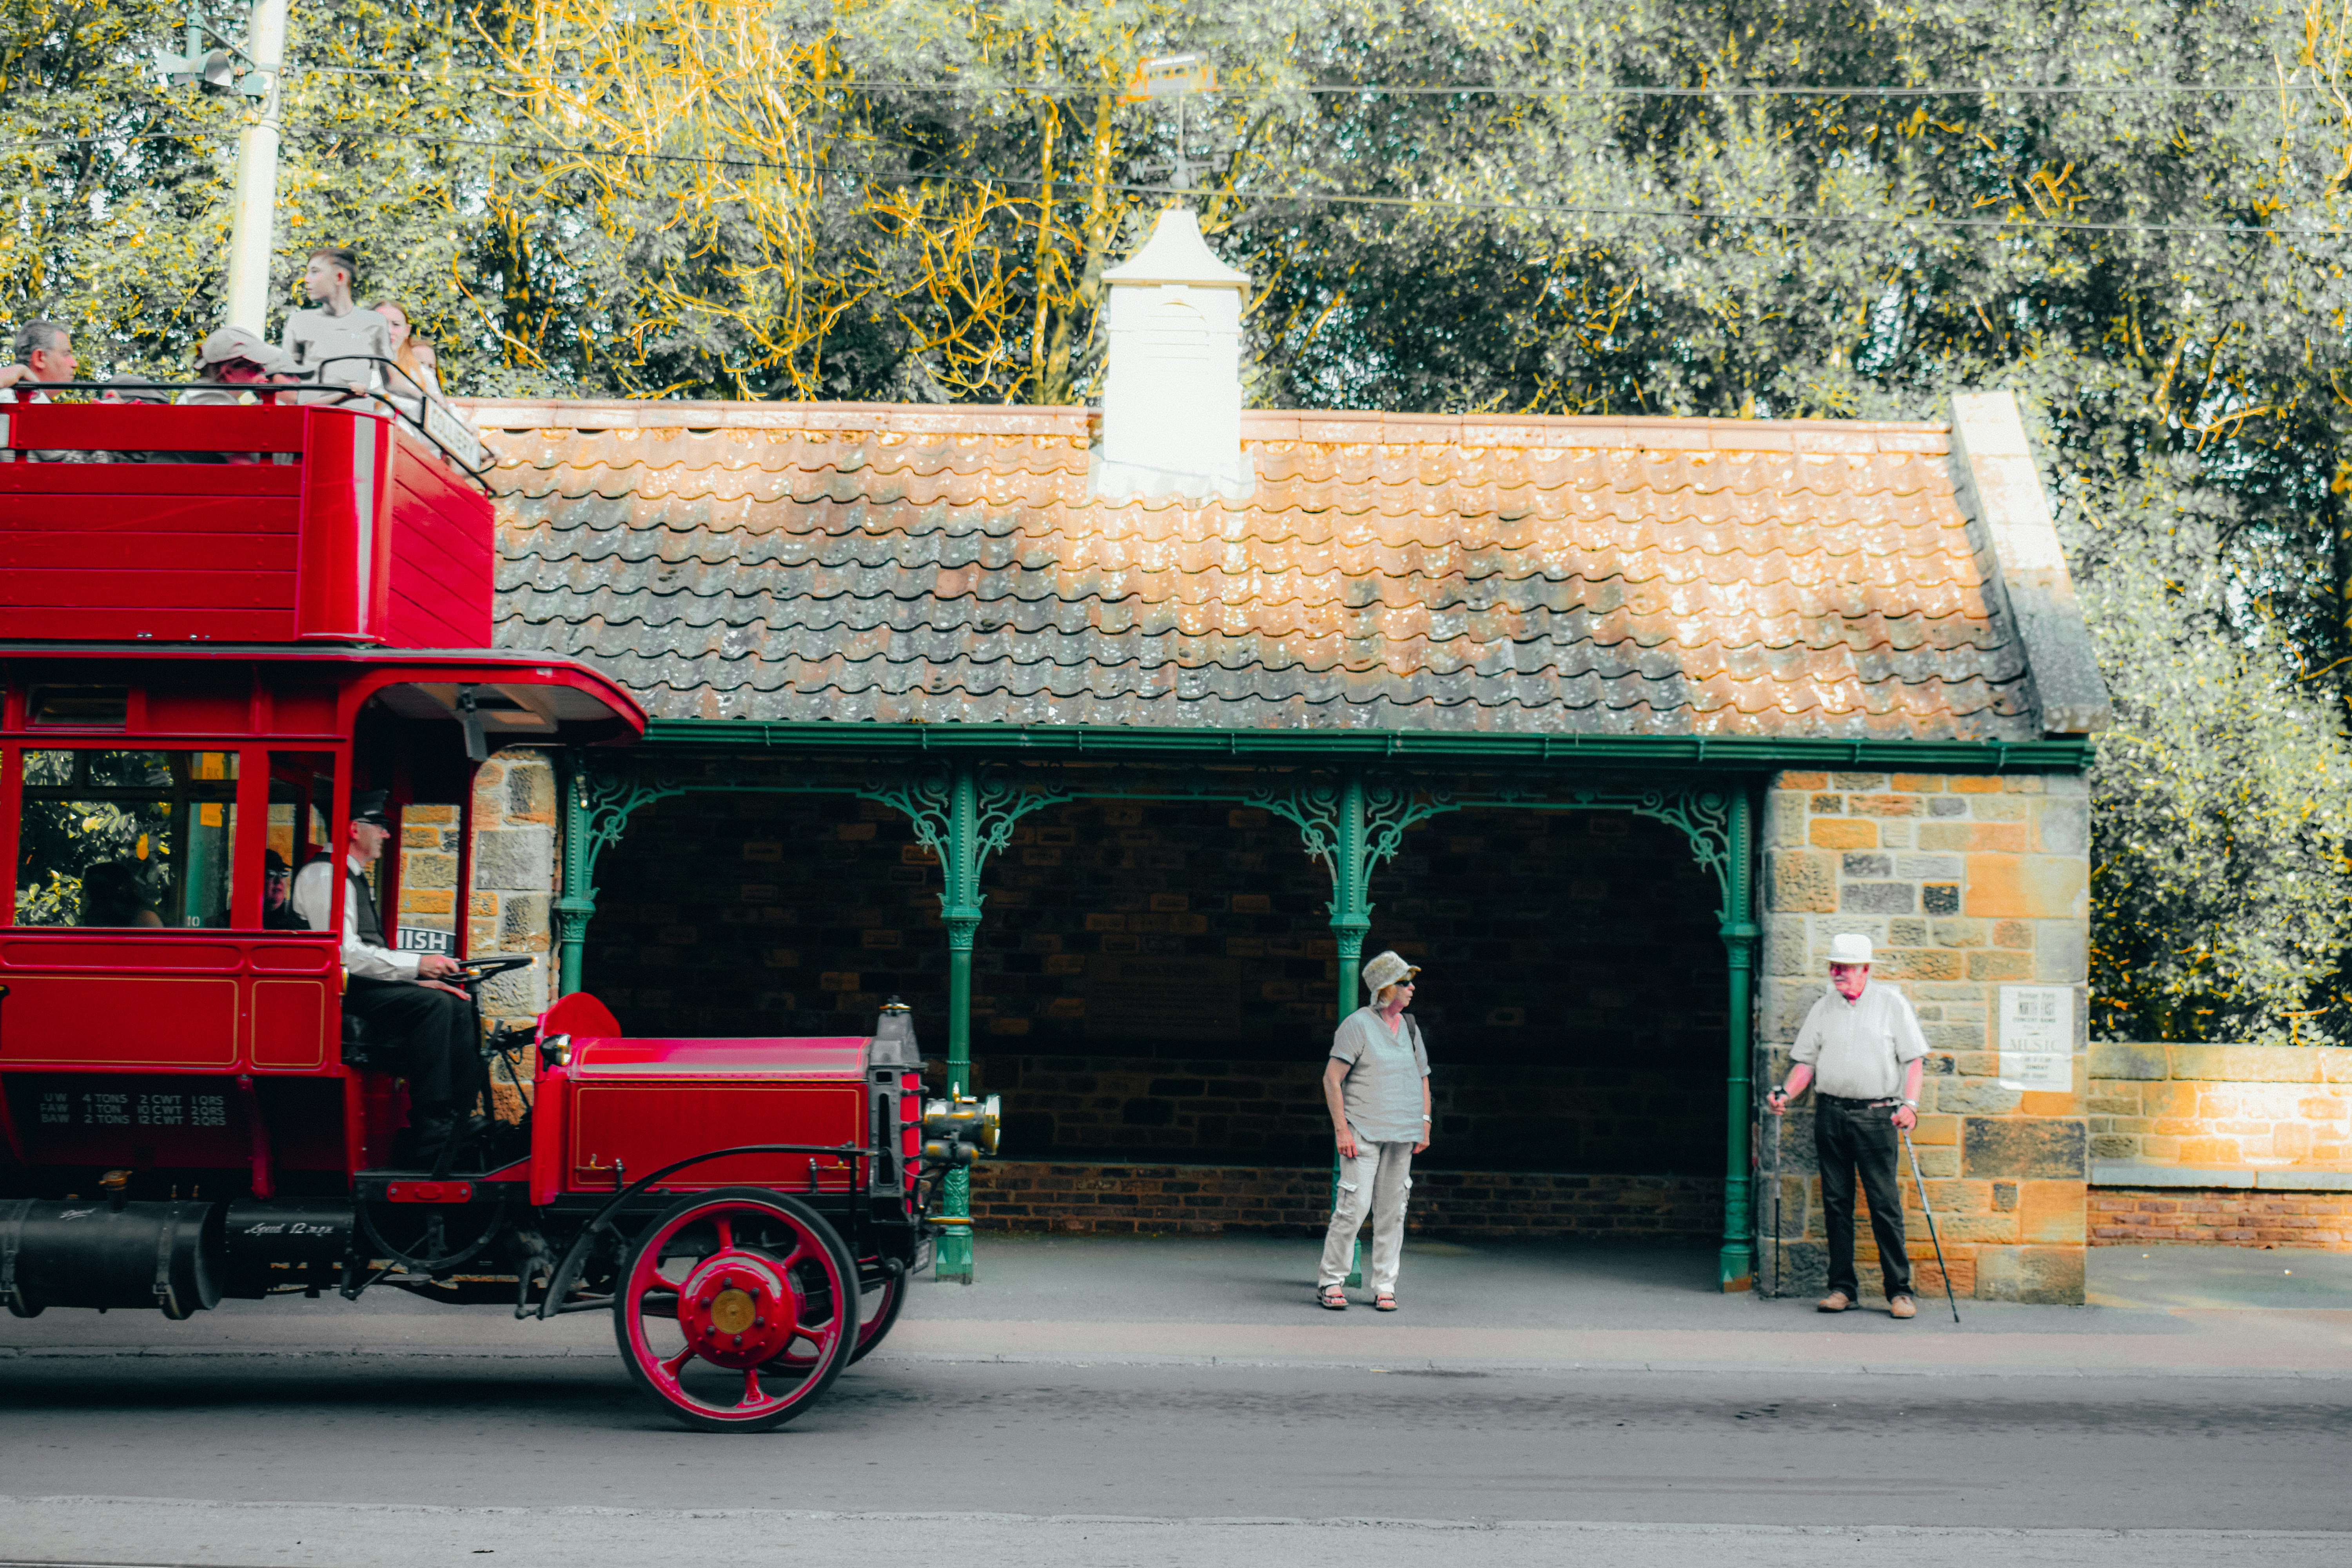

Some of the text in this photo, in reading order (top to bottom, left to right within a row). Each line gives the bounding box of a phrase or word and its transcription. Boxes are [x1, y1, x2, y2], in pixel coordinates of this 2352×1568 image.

[187, 916, 200, 926] 10
[82, 1094, 91, 1103] 4
[94, 1094, 128, 1103] TONS
[140, 1095, 148, 1103] 2
[151, 1095, 182, 1104] CWT
[40, 1103, 68, 1112] FAW
[87, 1104, 92, 1113] 1
[95, 1105, 122, 1114] TON
[137, 1105, 150, 1114] 10
[152, 1105, 182, 1115] CWT
[41, 1114, 70, 1123] BAW
[84, 1114, 93, 1124] 2
[96, 1115, 130, 1124] TONS
[138, 1116, 151, 1124] 12
[152, 1116, 183, 1125] CWT
[244, 1222, 286, 1236] Speed
[289, 1223, 307, 1234] 12
